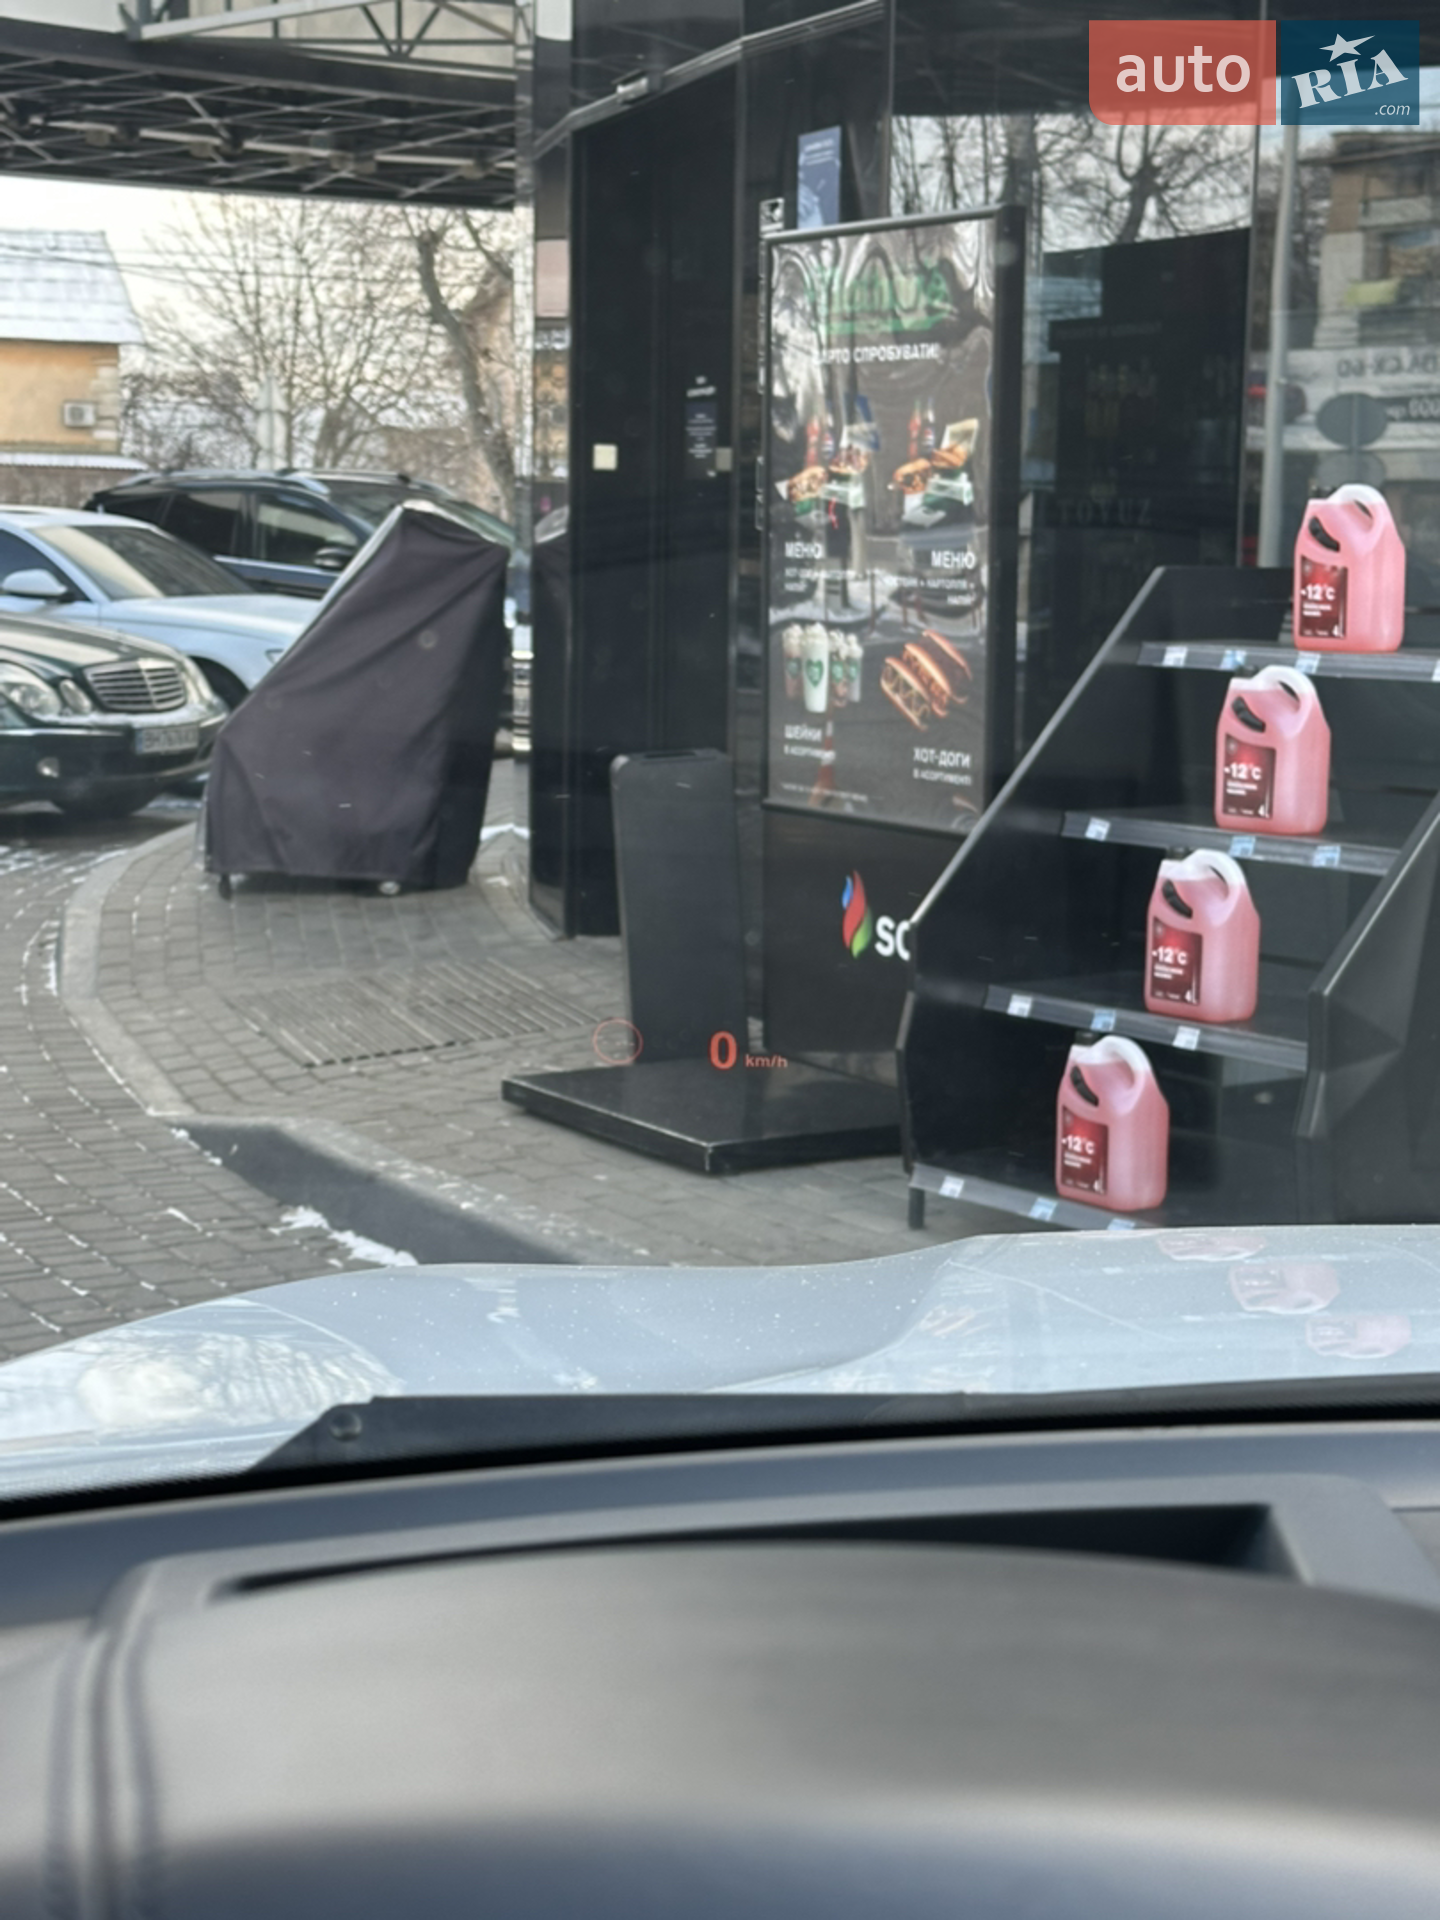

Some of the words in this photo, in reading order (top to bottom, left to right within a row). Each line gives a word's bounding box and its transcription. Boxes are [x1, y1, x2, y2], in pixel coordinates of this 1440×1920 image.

[785, 541, 823, 559] МЕНЮ
[931, 550, 976, 569] МЕНЮ
[913, 748, 971, 769] ХОТ-ДОГИ
[709, 1031, 738, 1069] 0
[745, 1053, 788, 1069] km/h
